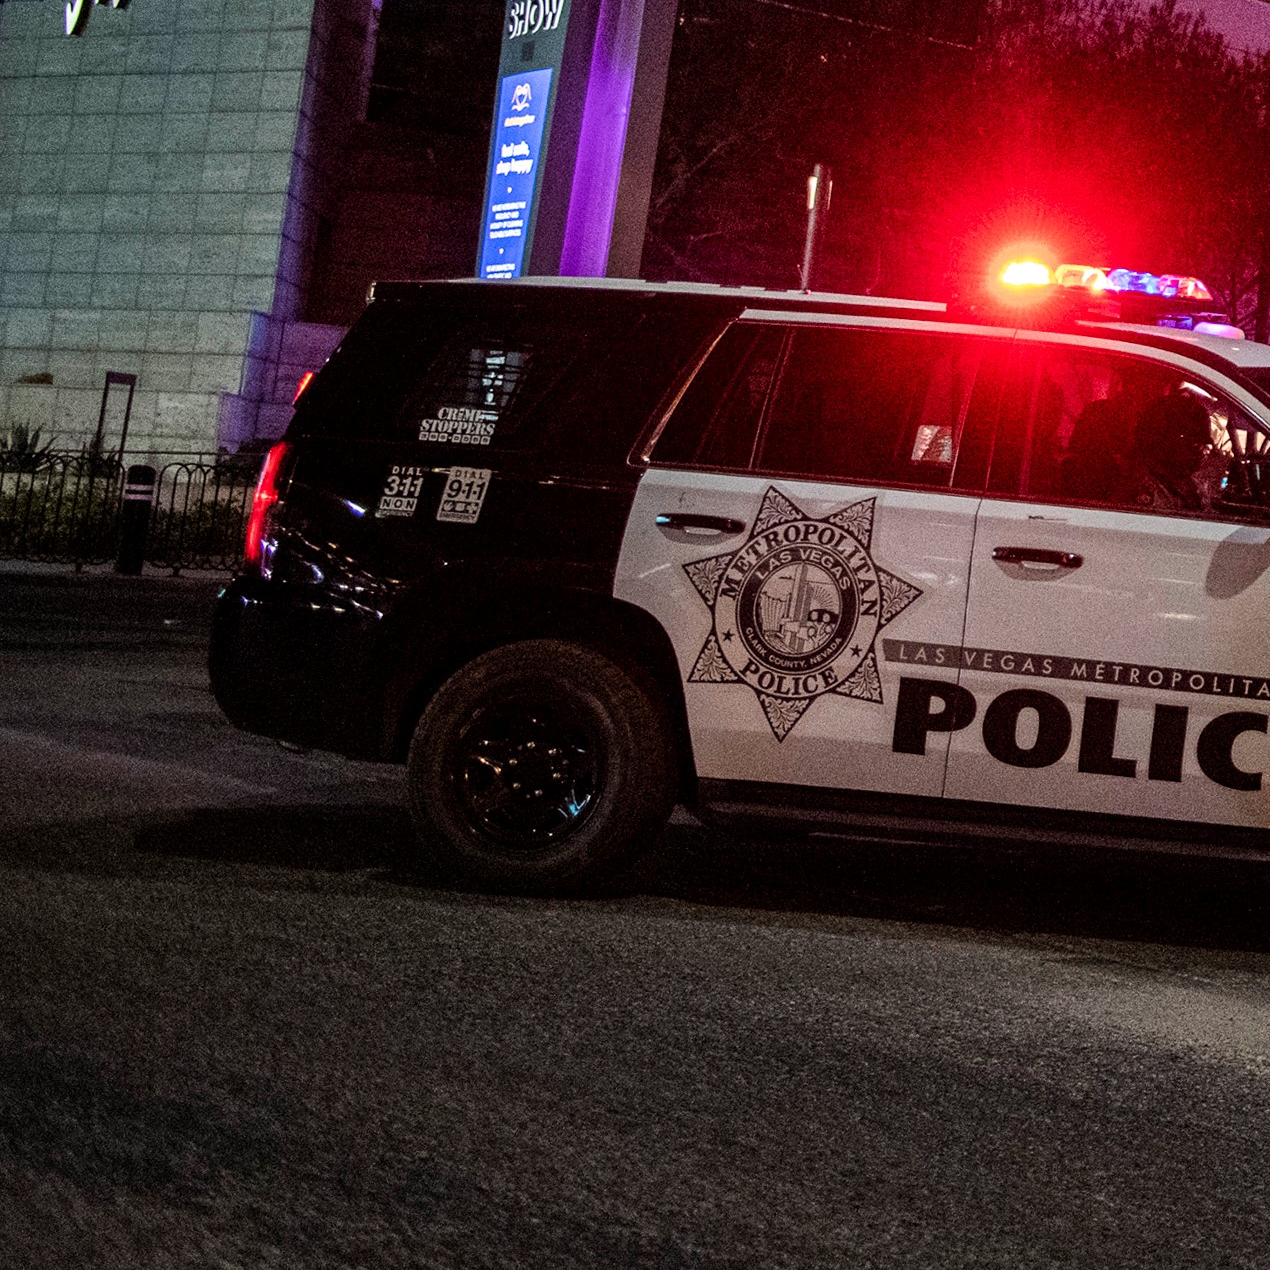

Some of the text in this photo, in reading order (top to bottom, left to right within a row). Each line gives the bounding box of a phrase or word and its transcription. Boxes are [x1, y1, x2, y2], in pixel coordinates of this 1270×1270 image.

[420, 418, 496, 436] STOPPERS
[392, 466, 423, 476] DIAL
[455, 470, 485, 479] DIAL
[382, 498, 415, 510] NON
[719, 523, 878, 618] METROPOLITAN
[755, 549, 851, 590] LAS VEGAS
[746, 627, 843, 669] CLARK COUNTY, NEVADA
[899, 644, 948, 664] LAS
[964, 650, 1054, 676] VEGAS
[738, 659, 839, 695] POLICE
